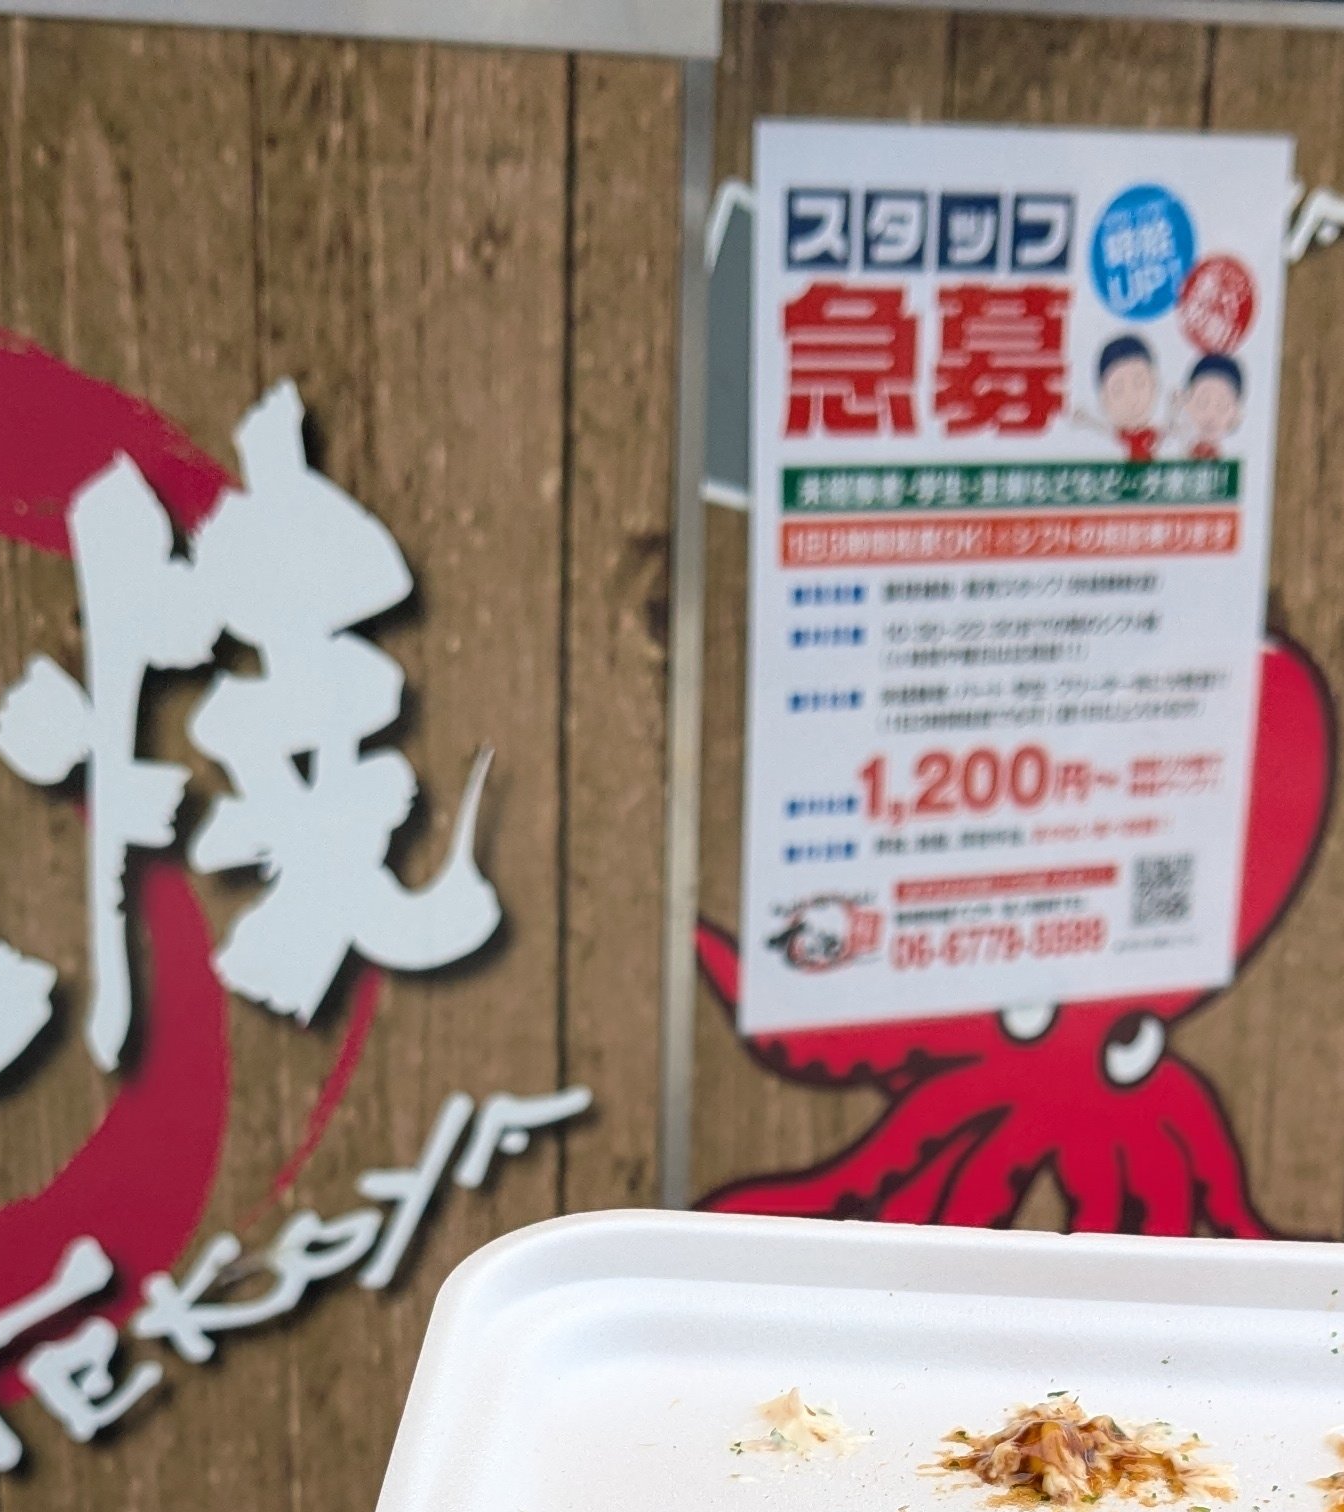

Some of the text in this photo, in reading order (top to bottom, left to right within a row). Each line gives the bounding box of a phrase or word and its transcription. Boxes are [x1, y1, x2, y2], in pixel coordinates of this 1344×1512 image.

[787, 188, 1074, 270] スタッフ
[781, 282, 1071, 438] 急募
